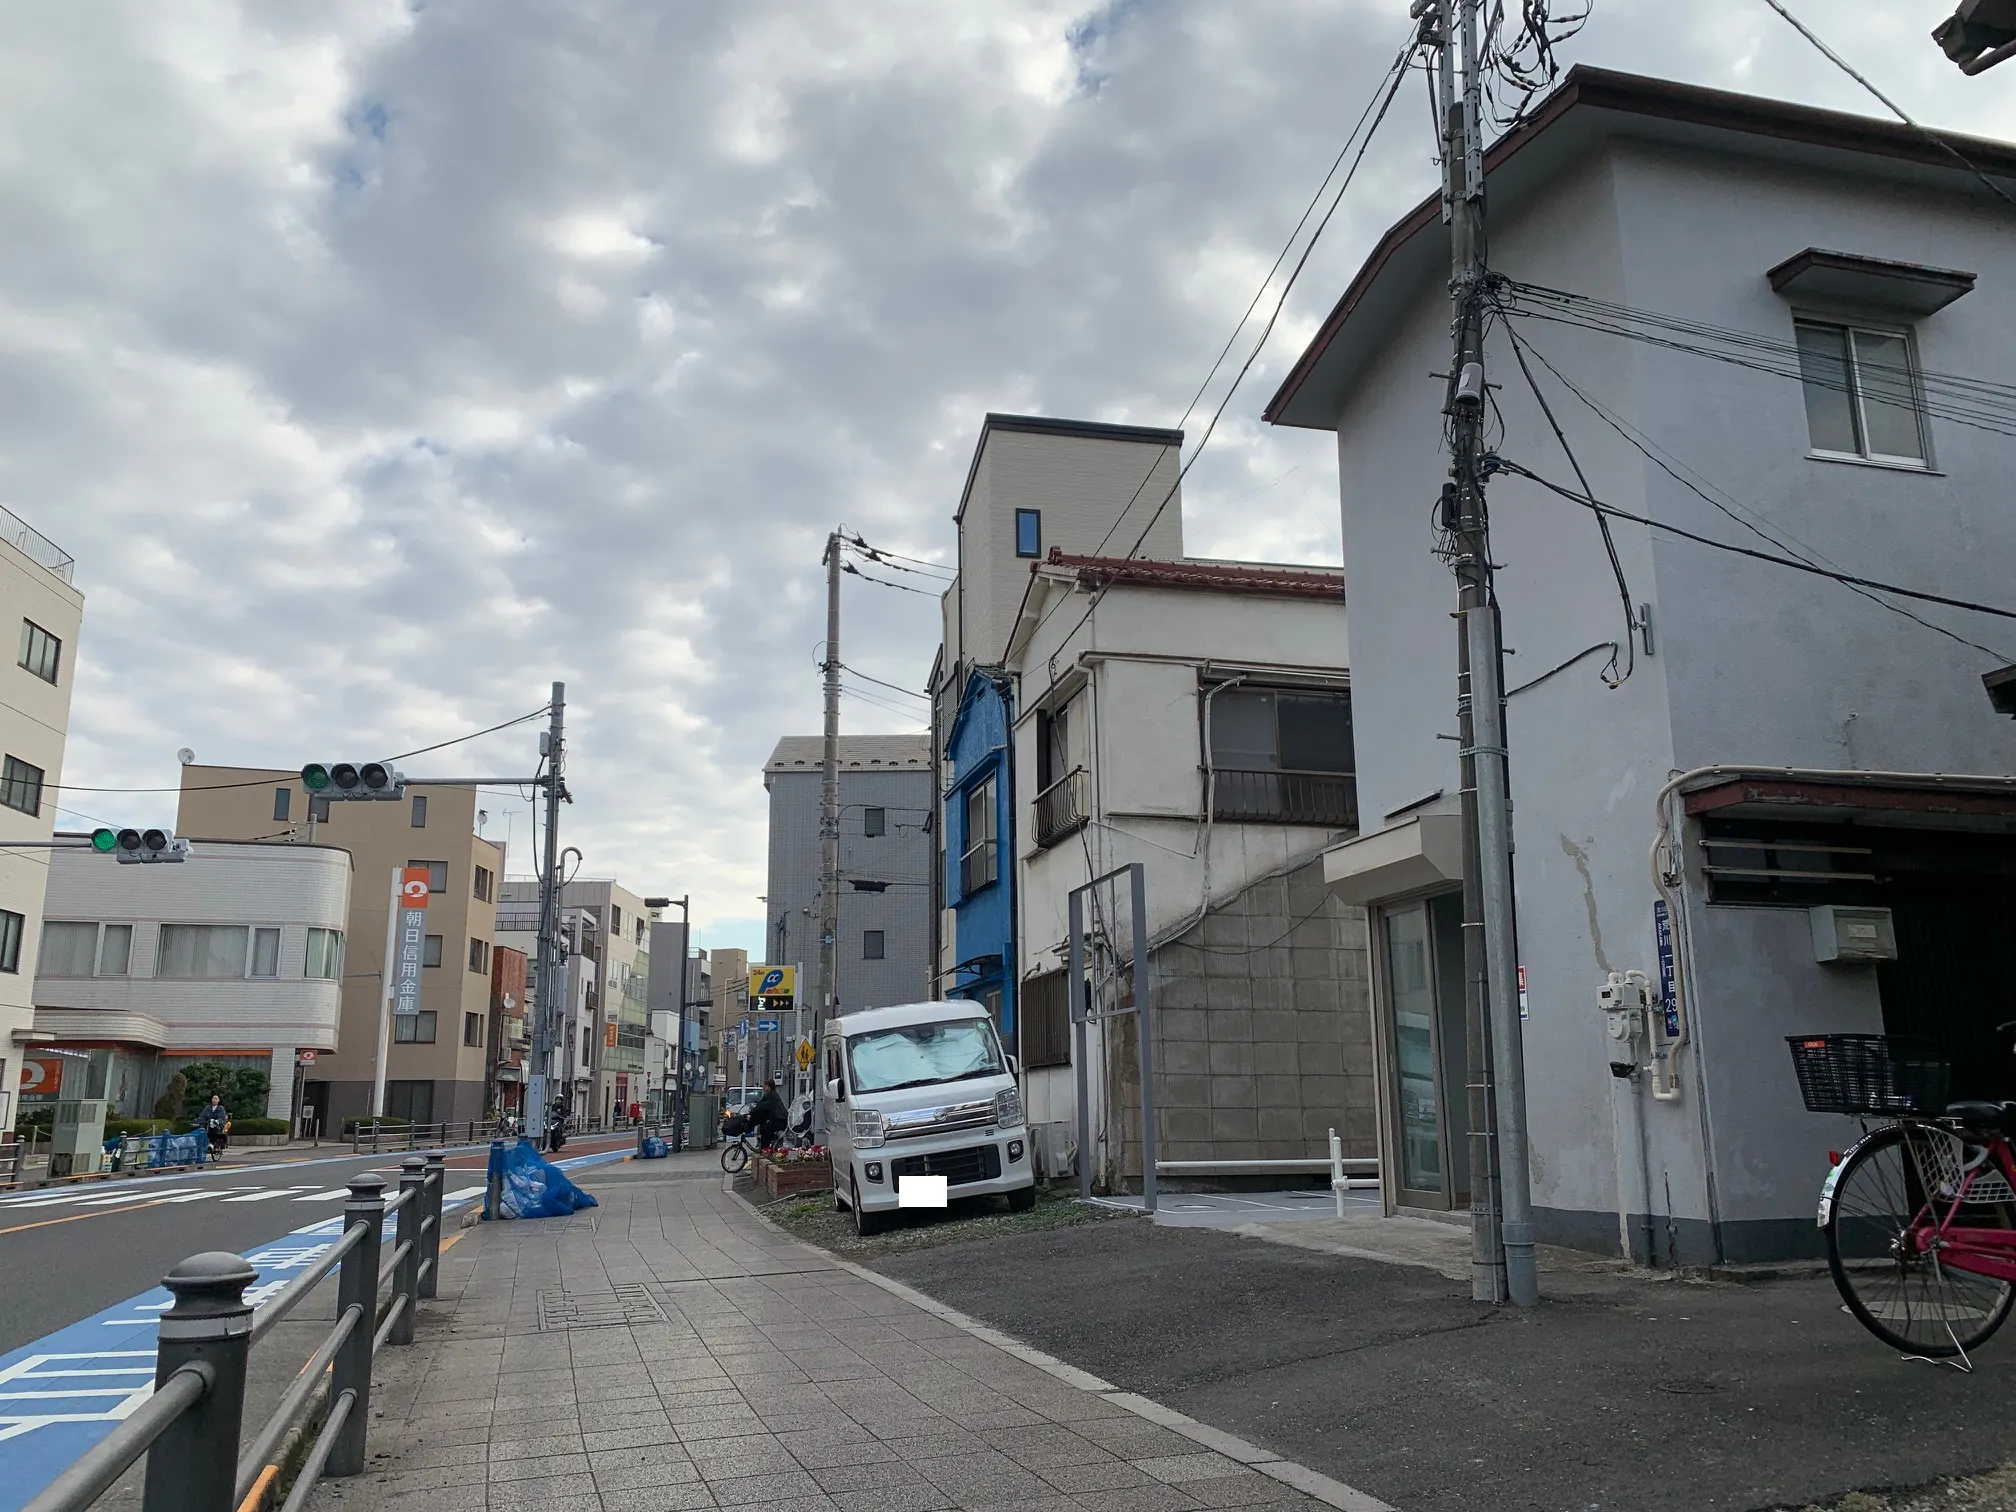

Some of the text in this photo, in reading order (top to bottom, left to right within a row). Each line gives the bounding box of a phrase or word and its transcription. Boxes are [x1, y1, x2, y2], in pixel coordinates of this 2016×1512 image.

[397, 911, 422, 1011] 朝日信用金庫
[1665, 998, 1677, 1012] 29
